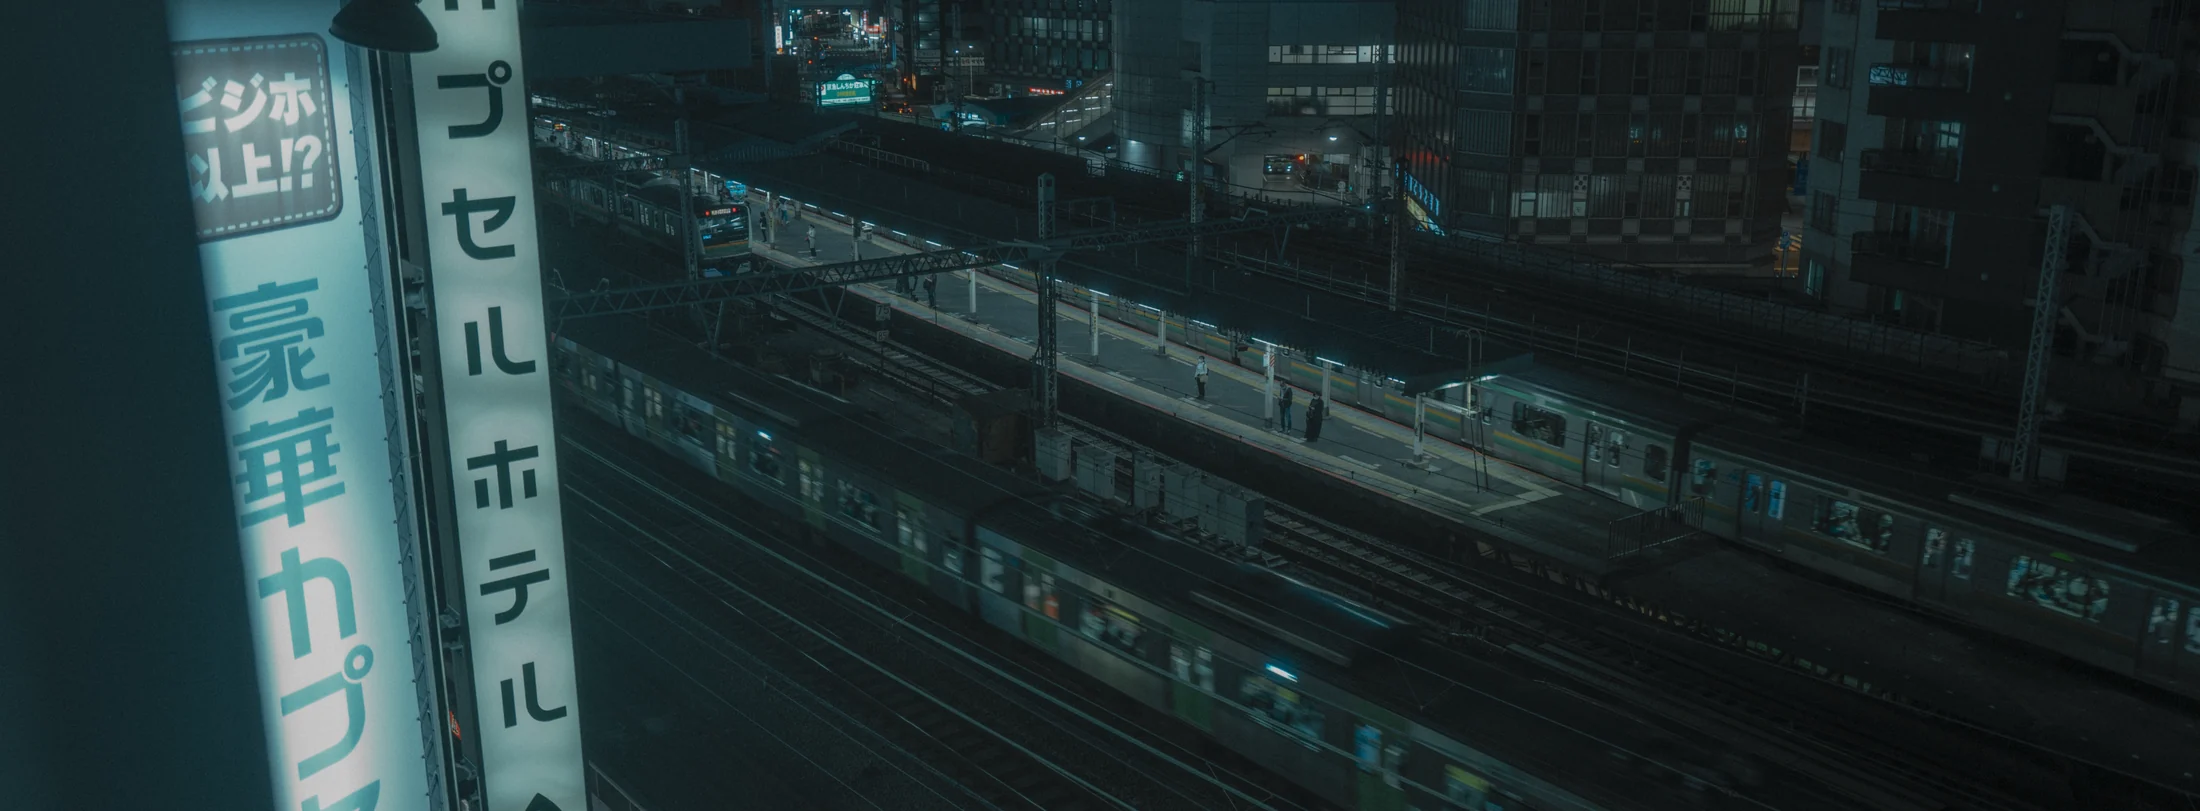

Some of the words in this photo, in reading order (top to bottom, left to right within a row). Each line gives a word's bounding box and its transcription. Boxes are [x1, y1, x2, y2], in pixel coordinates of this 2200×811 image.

[437, 0, 568, 729] プセルホテル
